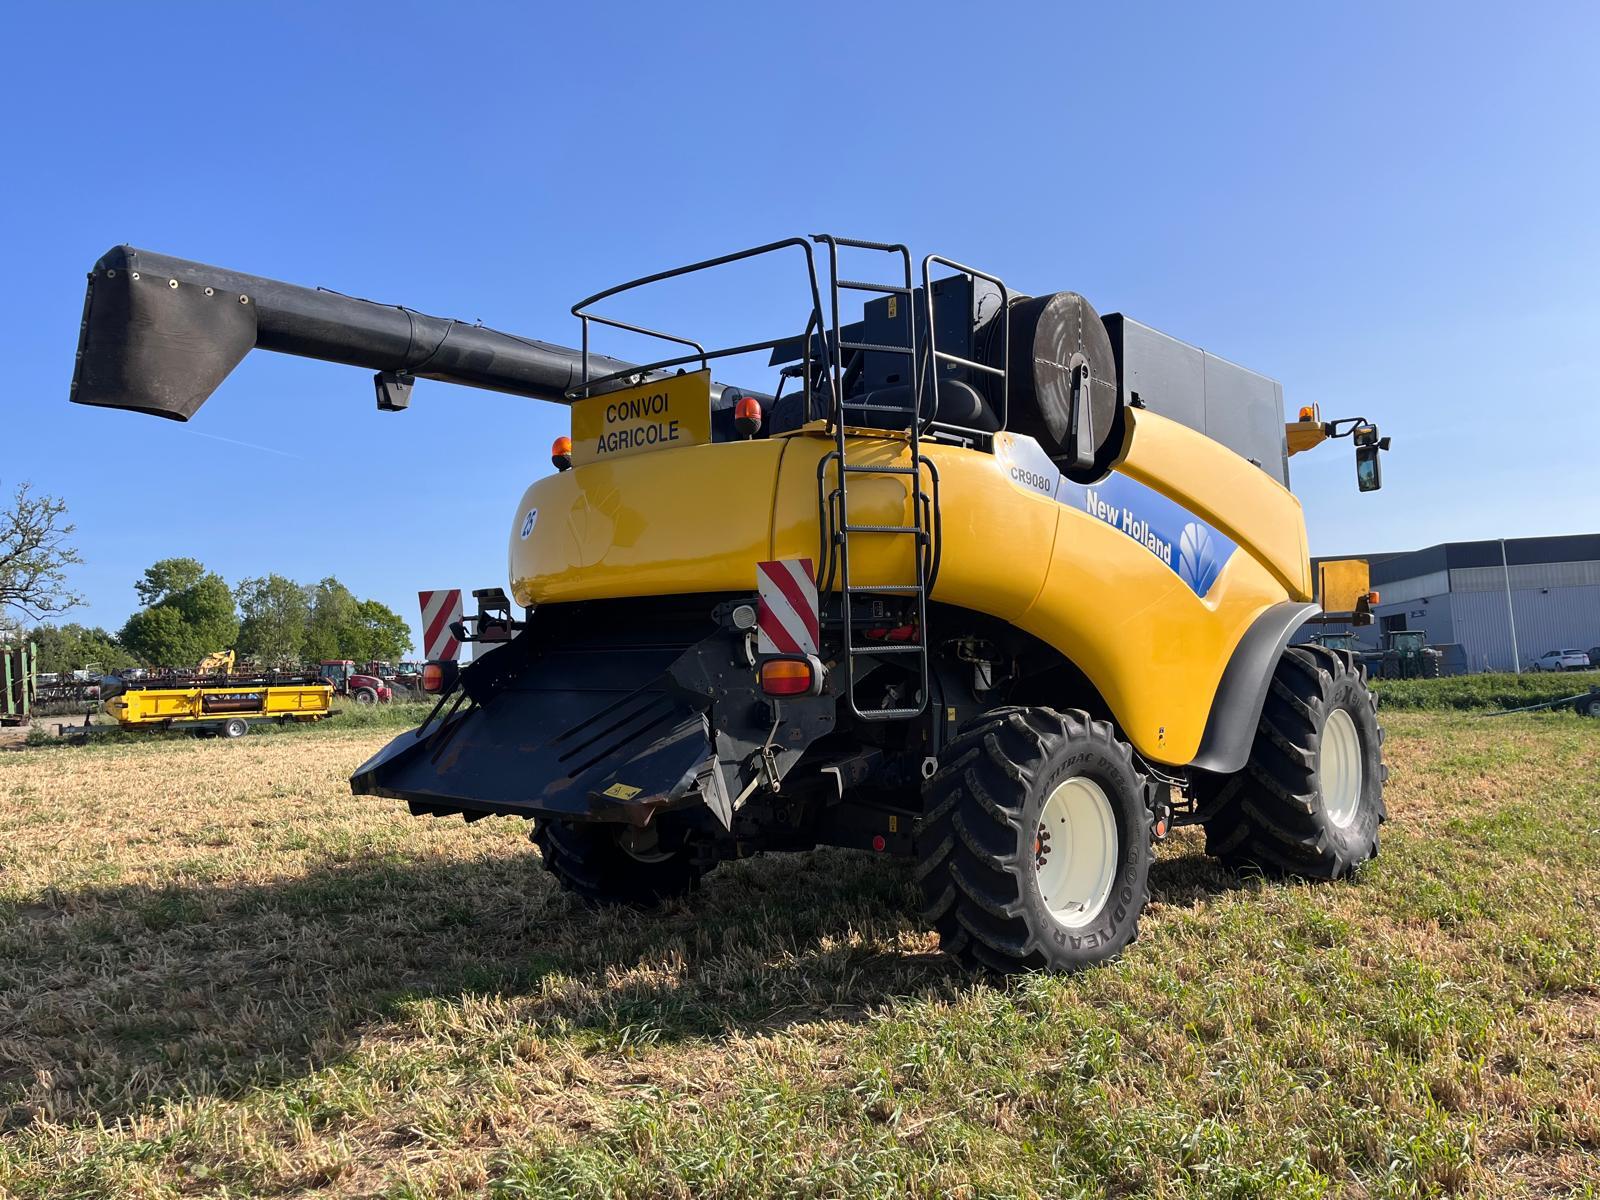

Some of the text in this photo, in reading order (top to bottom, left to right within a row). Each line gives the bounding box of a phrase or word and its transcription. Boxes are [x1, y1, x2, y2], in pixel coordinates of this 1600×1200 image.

[606, 393, 668, 423] CONVOI
[597, 420, 679, 454] AGRICOLE
[1010, 467, 1051, 492] CR9080
[1086, 489, 1172, 565] New Holland
[1053, 845, 1140, 951] GOODYEAR
